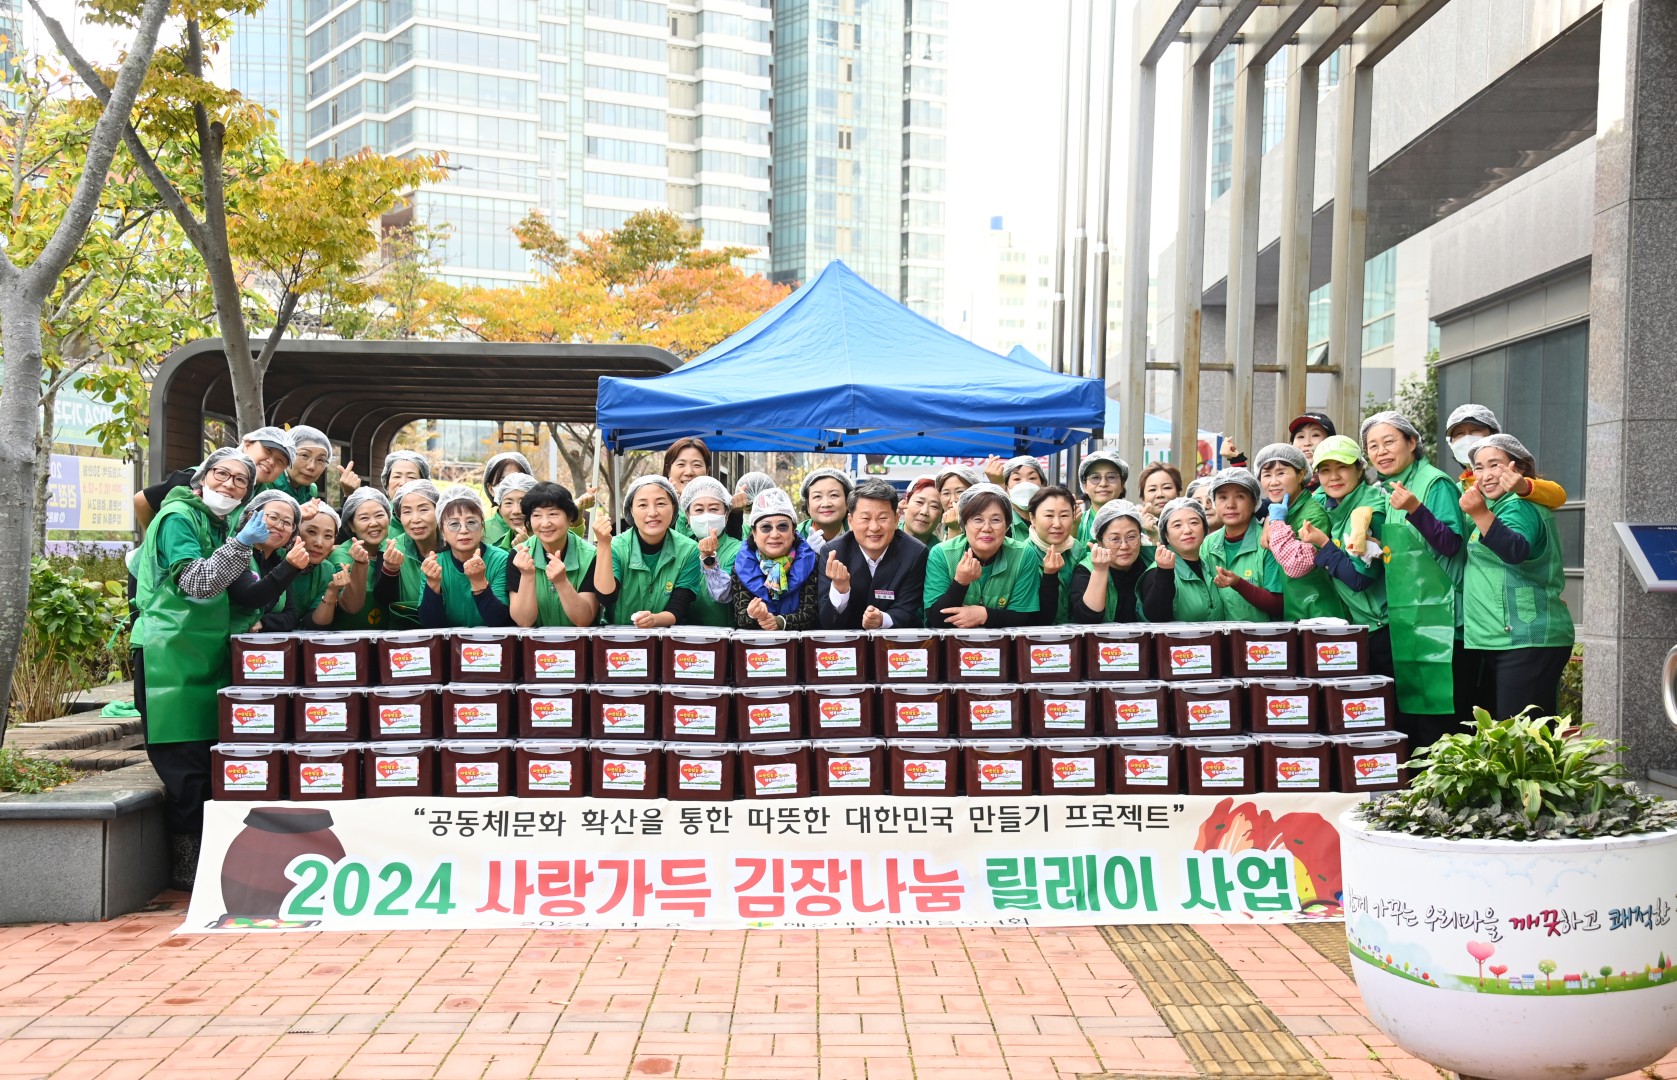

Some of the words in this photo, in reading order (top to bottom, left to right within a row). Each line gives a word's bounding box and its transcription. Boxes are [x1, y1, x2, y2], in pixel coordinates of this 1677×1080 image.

[582, 808, 663, 836] 확산을
[679, 806, 733, 834] 통한
[748, 804, 831, 836] 따뜻한
[845, 805, 954, 834] 대한민국
[969, 804, 1051, 833] 만들기
[287, 859, 457, 917] 2024
[476, 857, 712, 918] 사랑가득
[733, 856, 966, 918] 김장나눔
[986, 854, 1159, 913] 릴레이
[1181, 856, 1294, 913] 사업
[1372, 899, 1419, 927] 가꾸는
[1424, 904, 1504, 943] 우리마을
[1508, 908, 1602, 937] 깨끗하고
[1608, 897, 1671, 931] 쾌적한
